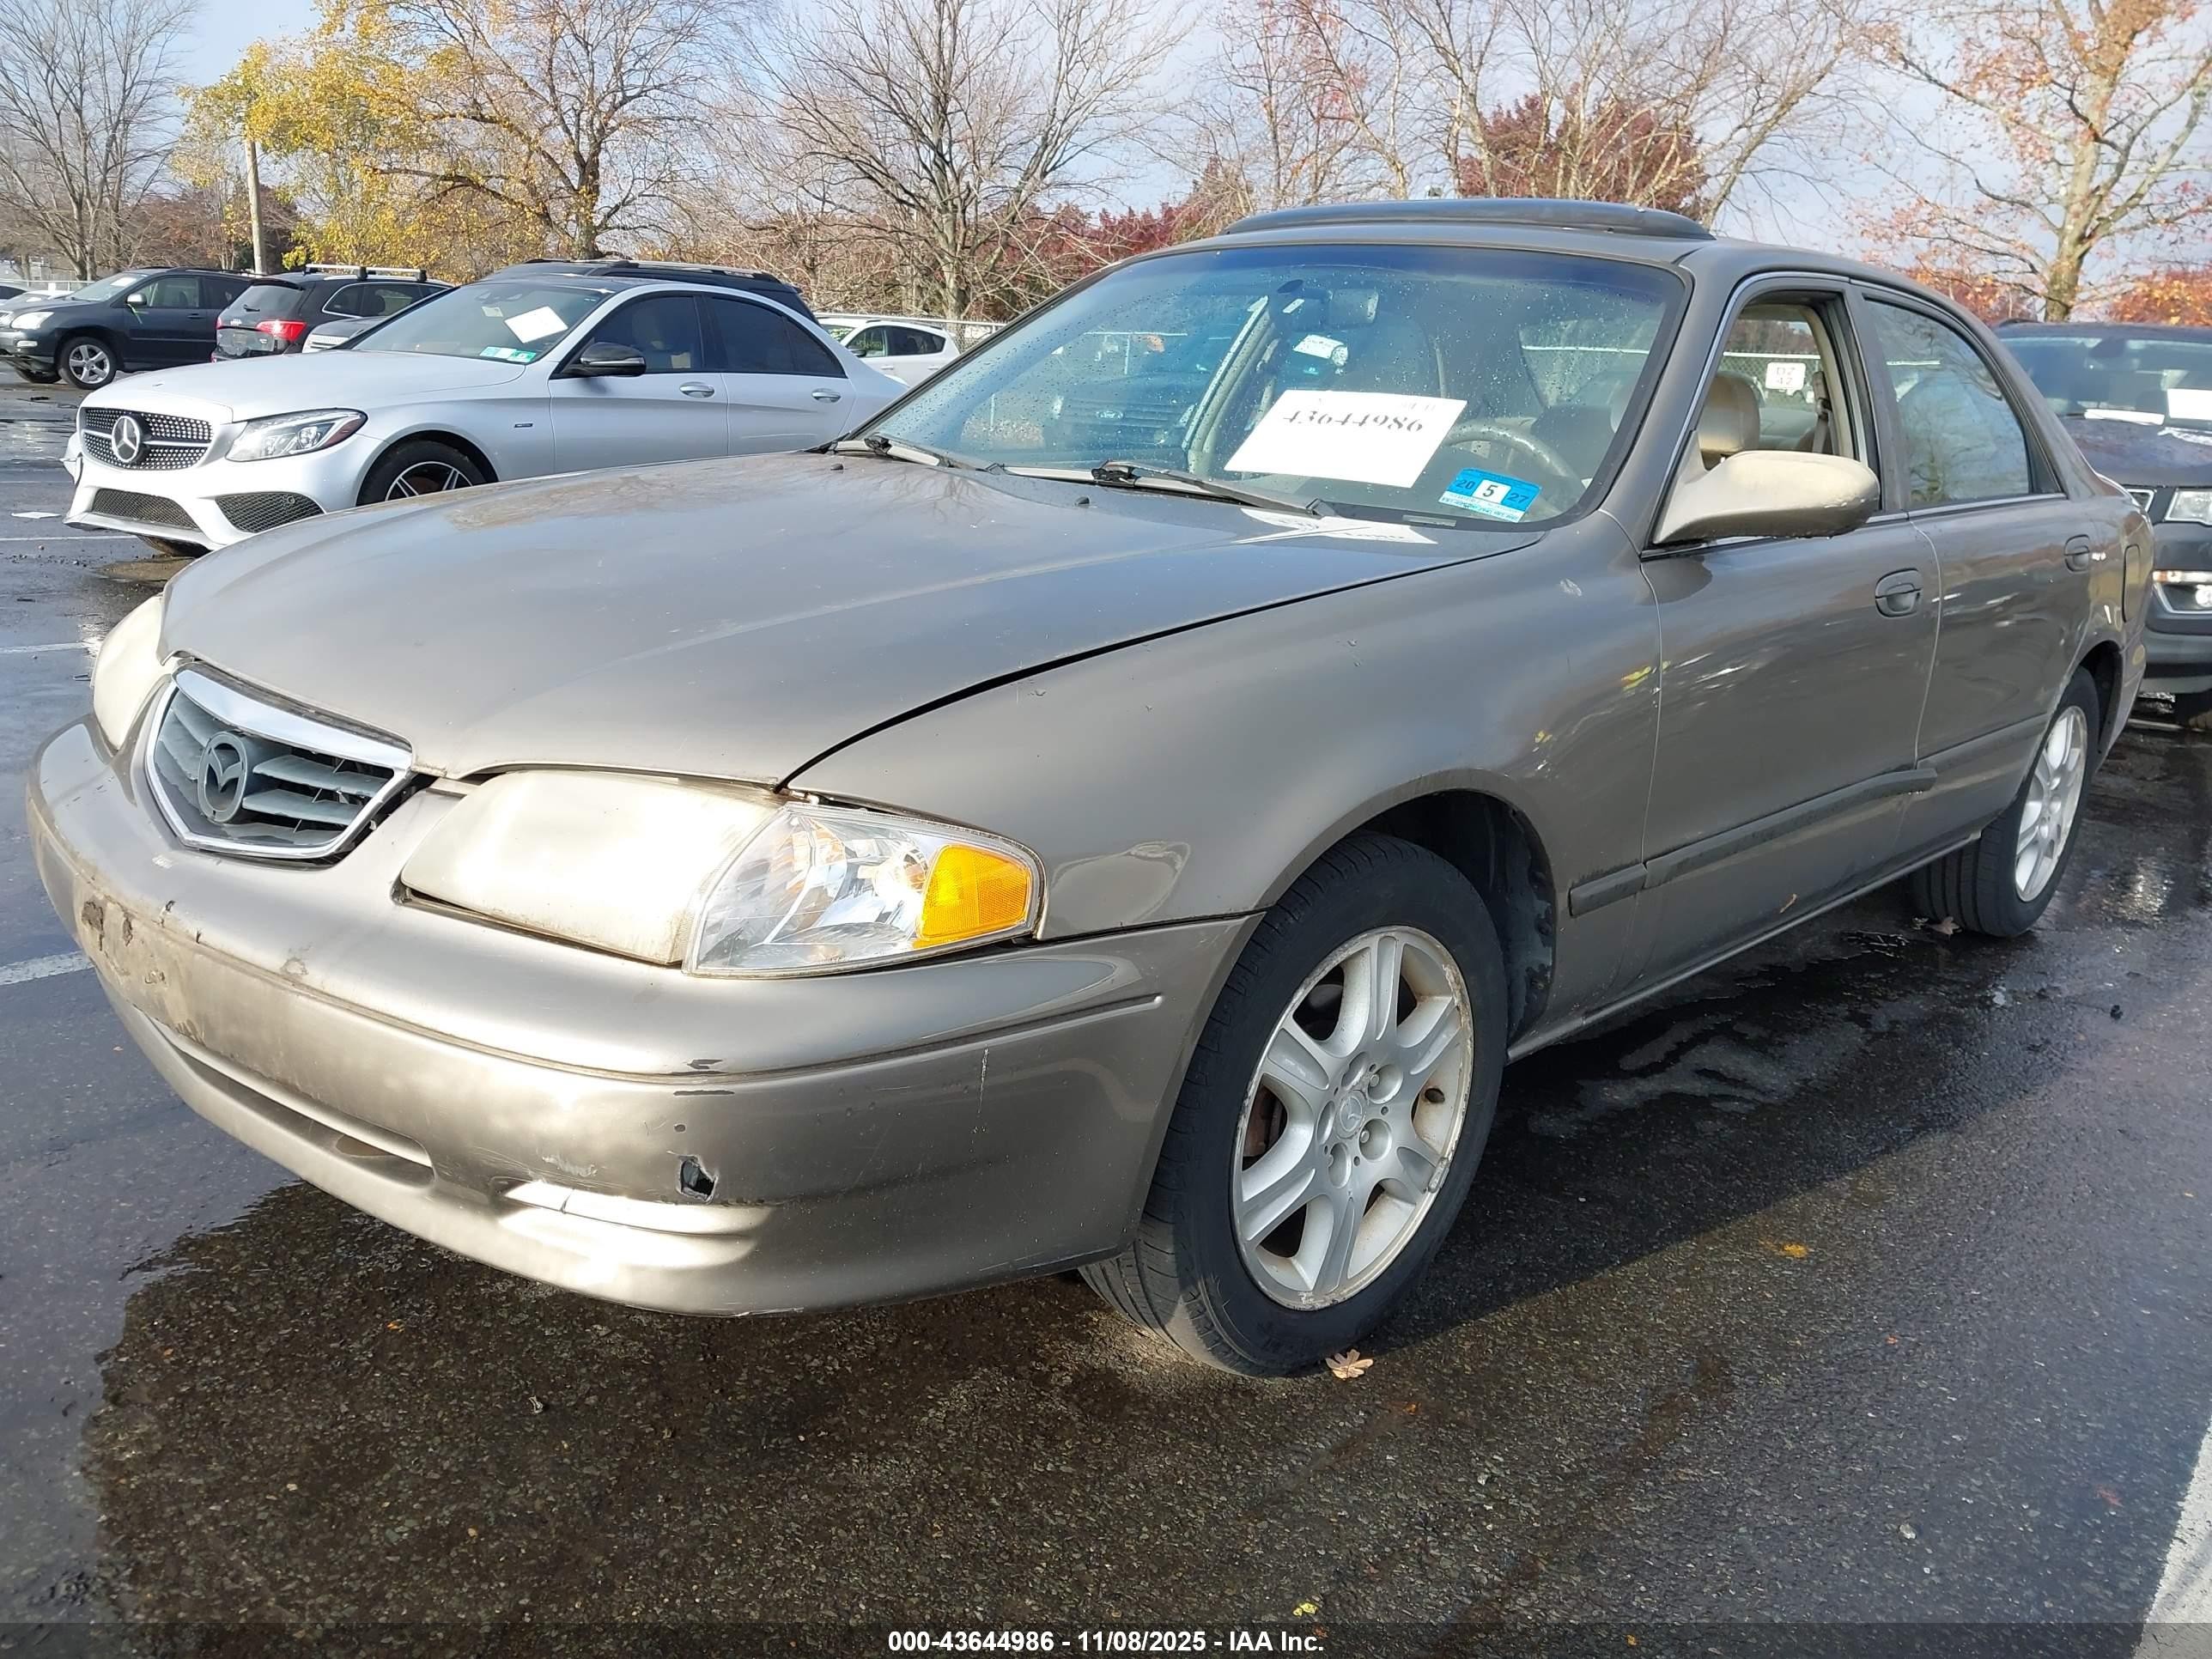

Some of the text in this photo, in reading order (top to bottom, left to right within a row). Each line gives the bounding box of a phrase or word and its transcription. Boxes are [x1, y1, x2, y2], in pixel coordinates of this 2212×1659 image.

[1455, 478, 1529, 504] 20 5 27
